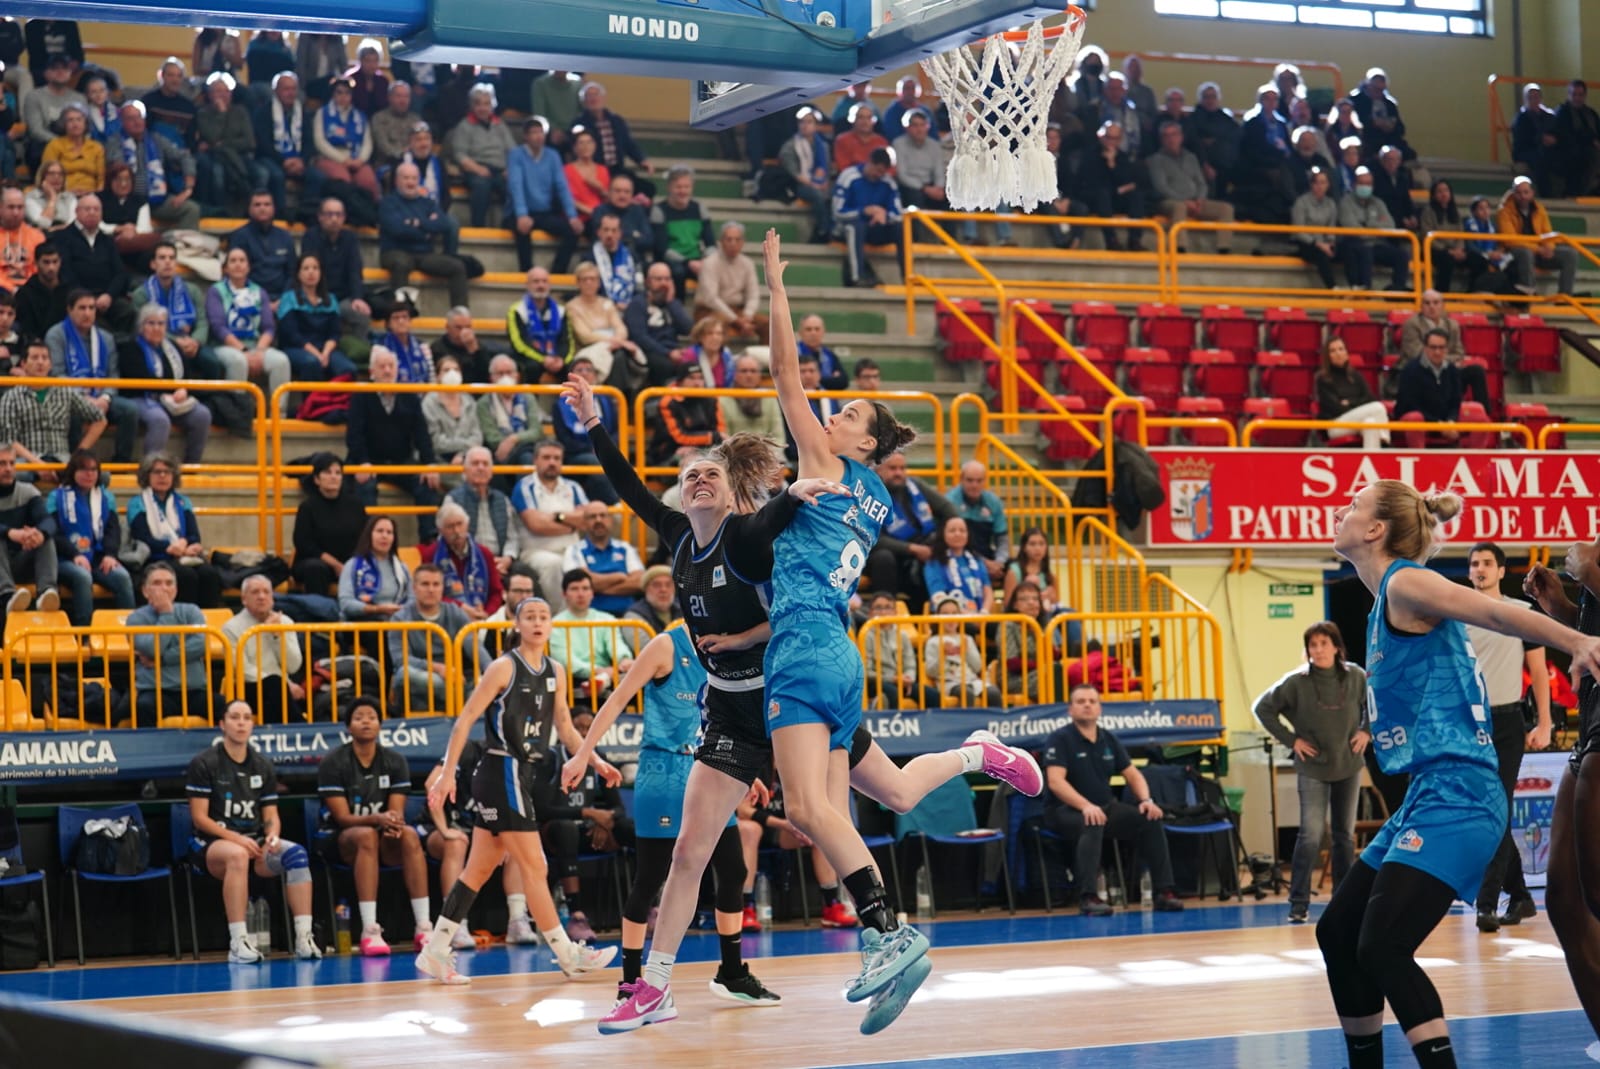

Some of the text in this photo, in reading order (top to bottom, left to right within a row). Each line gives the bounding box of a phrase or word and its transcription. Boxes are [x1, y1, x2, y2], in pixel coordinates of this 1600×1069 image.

[608, 14, 699, 42] MONDO
[1302, 455, 1600, 498] SALAMA
[1473, 505, 1522, 539] DE
[1532, 505, 1578, 539] LA
[689, 595, 709, 617] 21
[379, 722, 430, 748] EÓN
[867, 712, 921, 738] LEÓN
[0, 740, 117, 766] AMANCA
